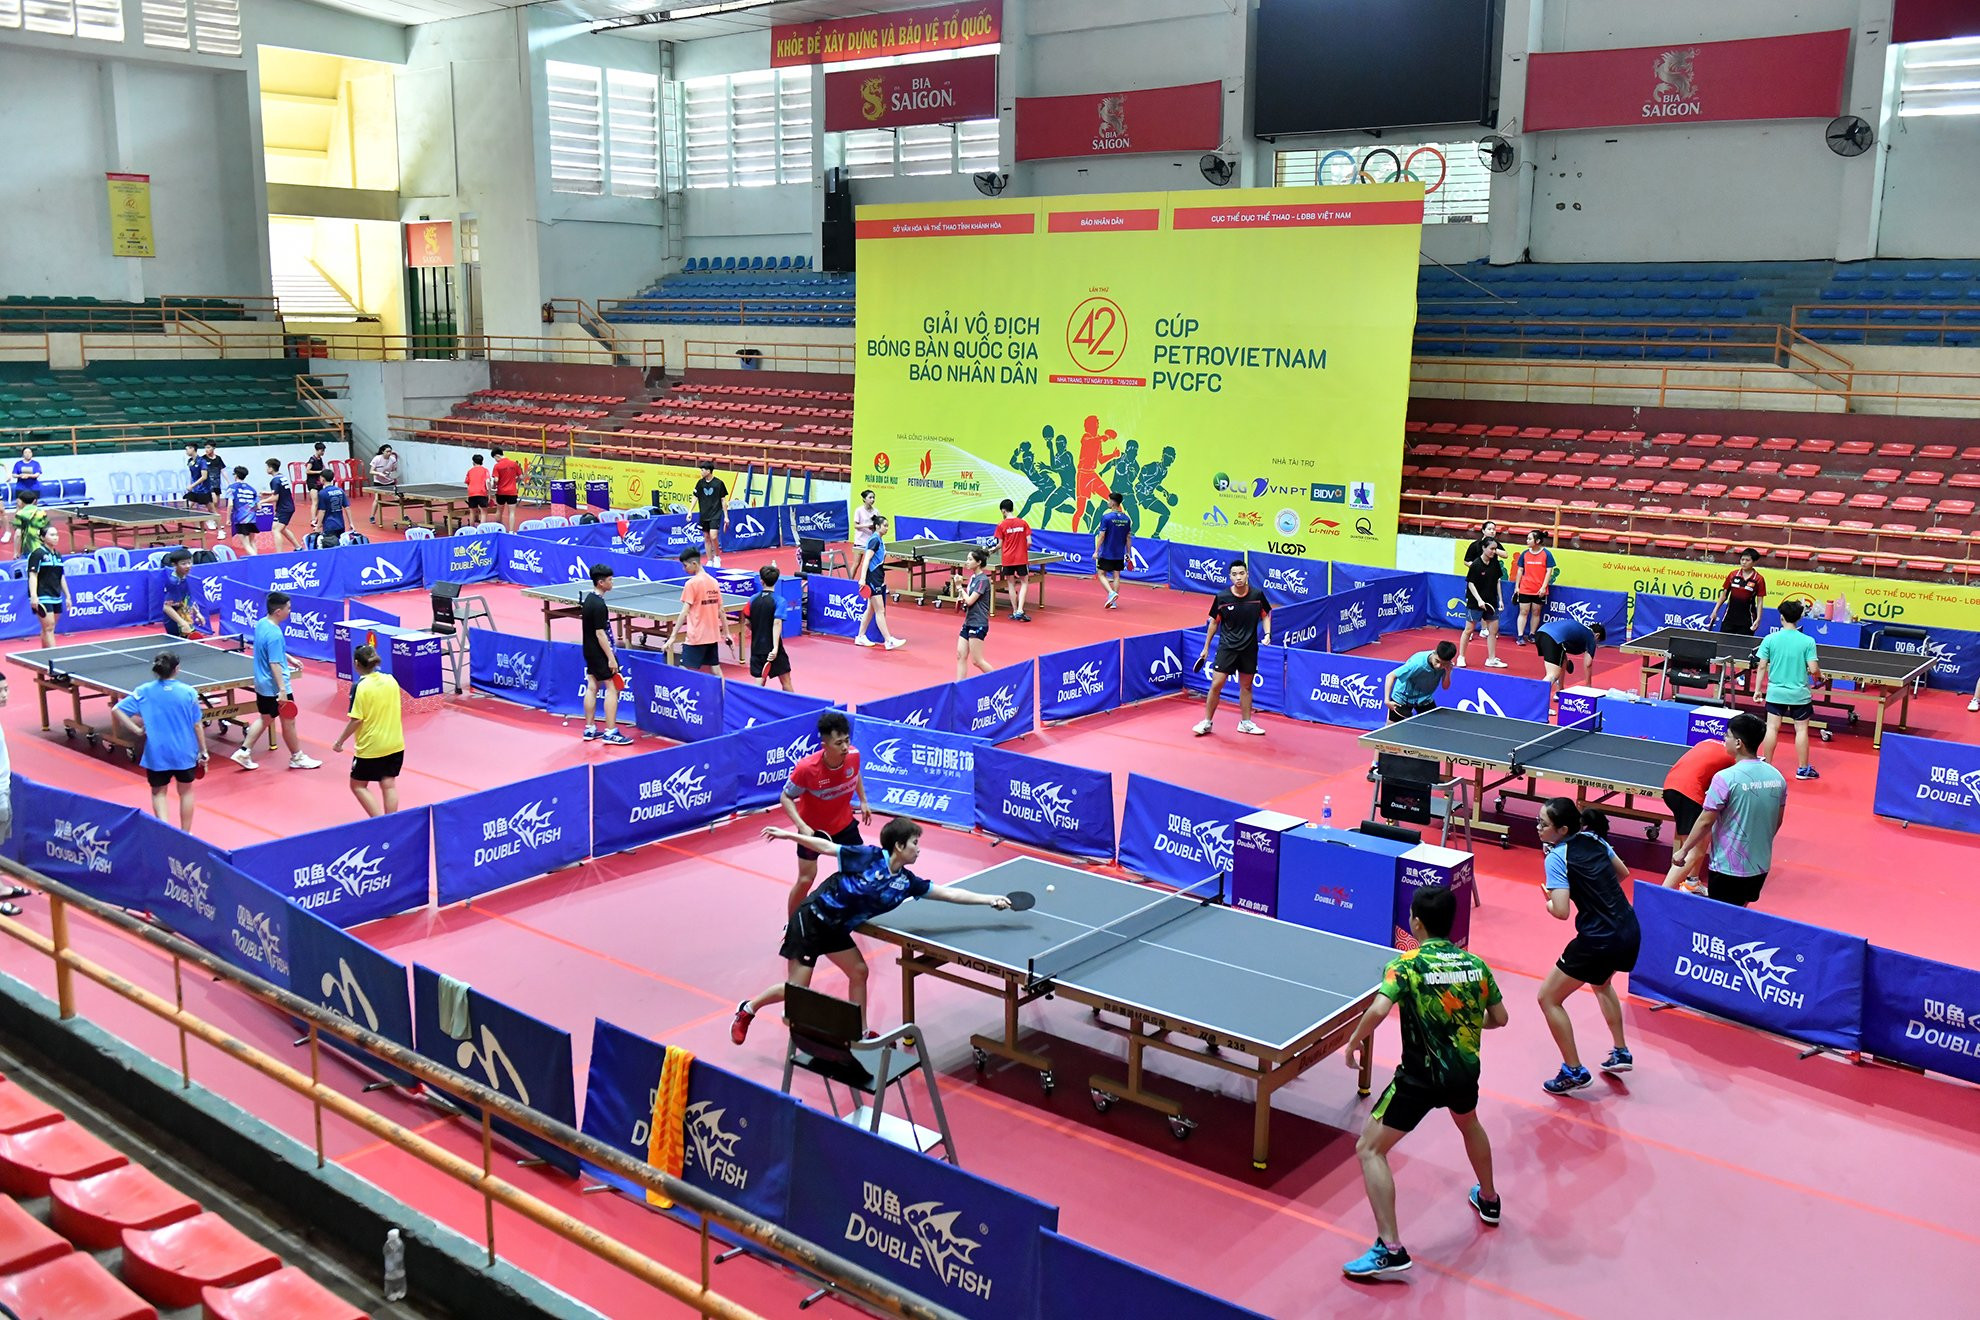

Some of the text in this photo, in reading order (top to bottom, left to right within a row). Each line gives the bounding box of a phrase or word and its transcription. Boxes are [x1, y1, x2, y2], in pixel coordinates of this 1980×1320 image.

[777, 8, 992, 57] KHỎE ĐỂ XÂY DỰNG VÀ BẢO VỆ TỔ QUỐC
[912, 78, 931, 89] BIA
[891, 89, 953, 112] SAIGON
[1662, 94, 1681, 103] BIA
[1641, 102, 1701, 118] SAIGON
[1092, 137, 1130, 150] SAIGON
[1081, 216, 1124, 226] BÁO NHÂN DÂN
[1211, 215, 1225, 223] CỤC
[1227, 212, 1240, 222] THỂ
[1241, 214, 1255, 223] DỤC
[1257, 211, 1270, 221] THỂ
[1317, 211, 1334, 220] VIỆT
[971, 222, 990, 230] KHÁNH
[924, 310, 1040, 339] GIẢI VÔ ĐỊCH
[1072, 306, 1116, 355] 42
[1155, 313, 1199, 338] CÚP
[867, 333, 1038, 360] BÓNG BÀN QUỐC GIA
[1153, 345, 1327, 369] PETROVIETNAM
[910, 359, 1038, 384] BÁO NHÂN DÂN
[1152, 371, 1221, 393] PVCFC
[1272, 457, 1315, 467] NHÀ TÀI TRỢ
[658, 477, 672, 489] CÚP
[960, 471, 974, 479] NPK
[629, 478, 641, 497] 42
[908, 478, 944, 489] PETROVIETNAM
[953, 480, 980, 492] PHÚ MỸ
[1270, 485, 1307, 496] VNPT
[1313, 488, 1336, 500] BIDV
[798, 525, 820, 533] DOUBLE
[1309, 527, 1340, 536] LI-NING
[668, 536, 688, 546] DOUBLE
[1267, 541, 1306, 556] VLOOP
[450, 559, 474, 573] DOUBLE
[1603, 562, 1727, 580] SỞ VĂN HÓA VÀ THỂ THAO TỈNH KHÁNH
[361, 576, 402, 586] MOFIT
[1186, 569, 1208, 582] DOUBLE
[270, 580, 298, 592] DOUBLE
[1264, 579, 1288, 591] DOUBLE
[1633, 577, 1694, 599] GIẢI VÔ
[1776, 578, 1830, 591] BÁO NHÂN DÂN
[1864, 588, 1882, 597] CỤC
[1883, 588, 1899, 598] THỂ
[1900, 591, 1917, 601] DỤC
[1918, 591, 1936, 601] THỂ
[1936, 594, 1957, 603] THAO
[70, 604, 104, 618] DOUBLE
[824, 608, 847, 620] DOUBLE
[1378, 608, 1398, 618] DOUBLE
[1863, 600, 1904, 619] CÚP
[1292, 626, 1317, 643] ENLIO
[493, 672, 520, 688] DOUBLE
[1149, 671, 1183, 683] MOFIT
[1058, 686, 1082, 703] DOUBLE
[1311, 688, 1383, 710] DOUBLE FISH
[651, 700, 678, 719] DOUBLE
[972, 714, 996, 731] DOUBLE
[912, 742, 975, 772] 运动服饰
[1446, 755, 1497, 771] MOFIT
[865, 761, 909, 776] Double Fish
[882, 787, 952, 812] 双鱼体育
[1916, 784, 1973, 807] DOUBLE
[629, 791, 712, 823] DOUBLE FISH
[1003, 798, 1080, 831] DOUBLE FISH
[46, 840, 84, 865] DOUBLE
[474, 826, 561, 868] DOUBLE FISH
[1154, 833, 1233, 872] DOUBLE FIS
[360, 874, 392, 895] FISH
[164, 878, 193, 909] DOUBLE
[1313, 893, 1336, 906] DOUBLE
[957, 955, 1020, 982] MOFIT
[1467, 968, 1483, 982] CITY
[1674, 955, 1804, 1009] DOUBLE FISH
[1227, 1038, 1246, 1052] 235
[712, 1156, 748, 1190] FISH
[844, 1212, 993, 1301] DOUBLE FISH
